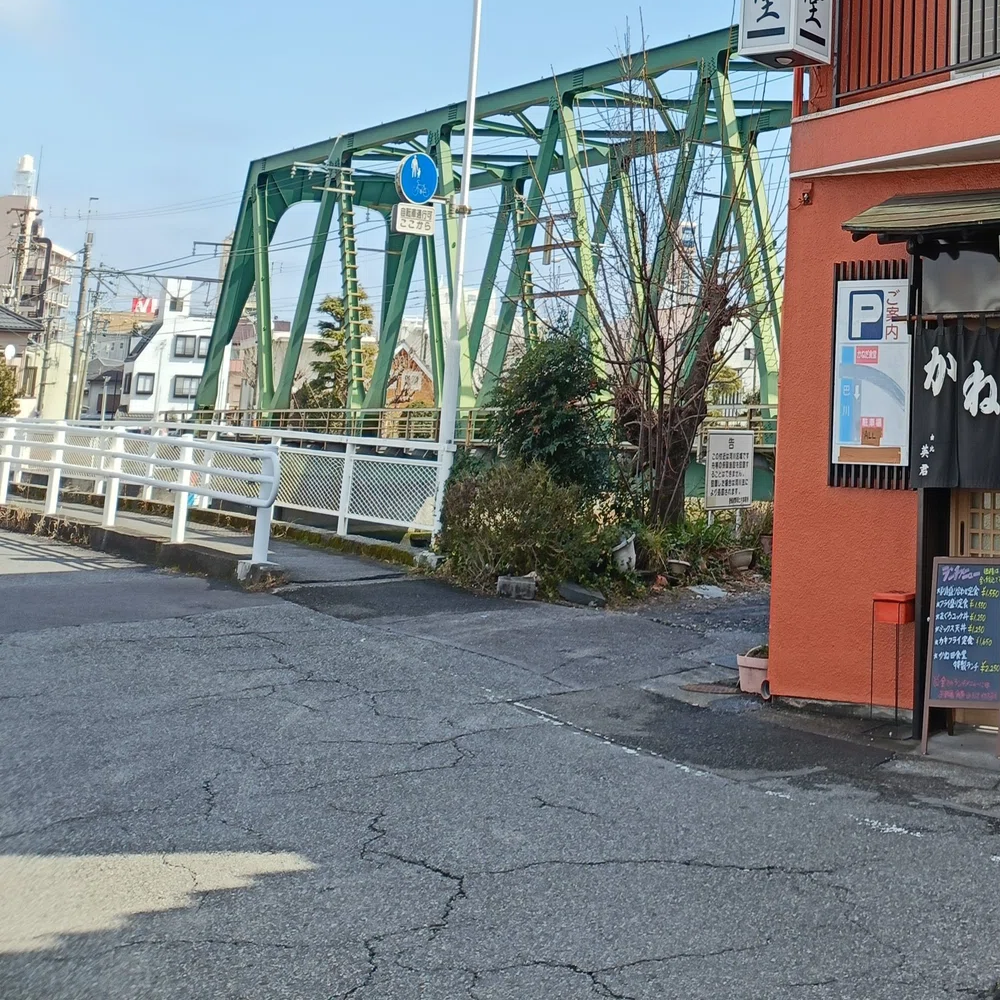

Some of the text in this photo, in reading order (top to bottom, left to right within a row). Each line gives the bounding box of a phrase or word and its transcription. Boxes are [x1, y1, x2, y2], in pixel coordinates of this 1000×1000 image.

[399, 218, 432, 231] ここから
[400, 207, 433, 221] 自転車通行可
[851, 292, 883, 339] P
[885, 289, 901, 340] ご案内
